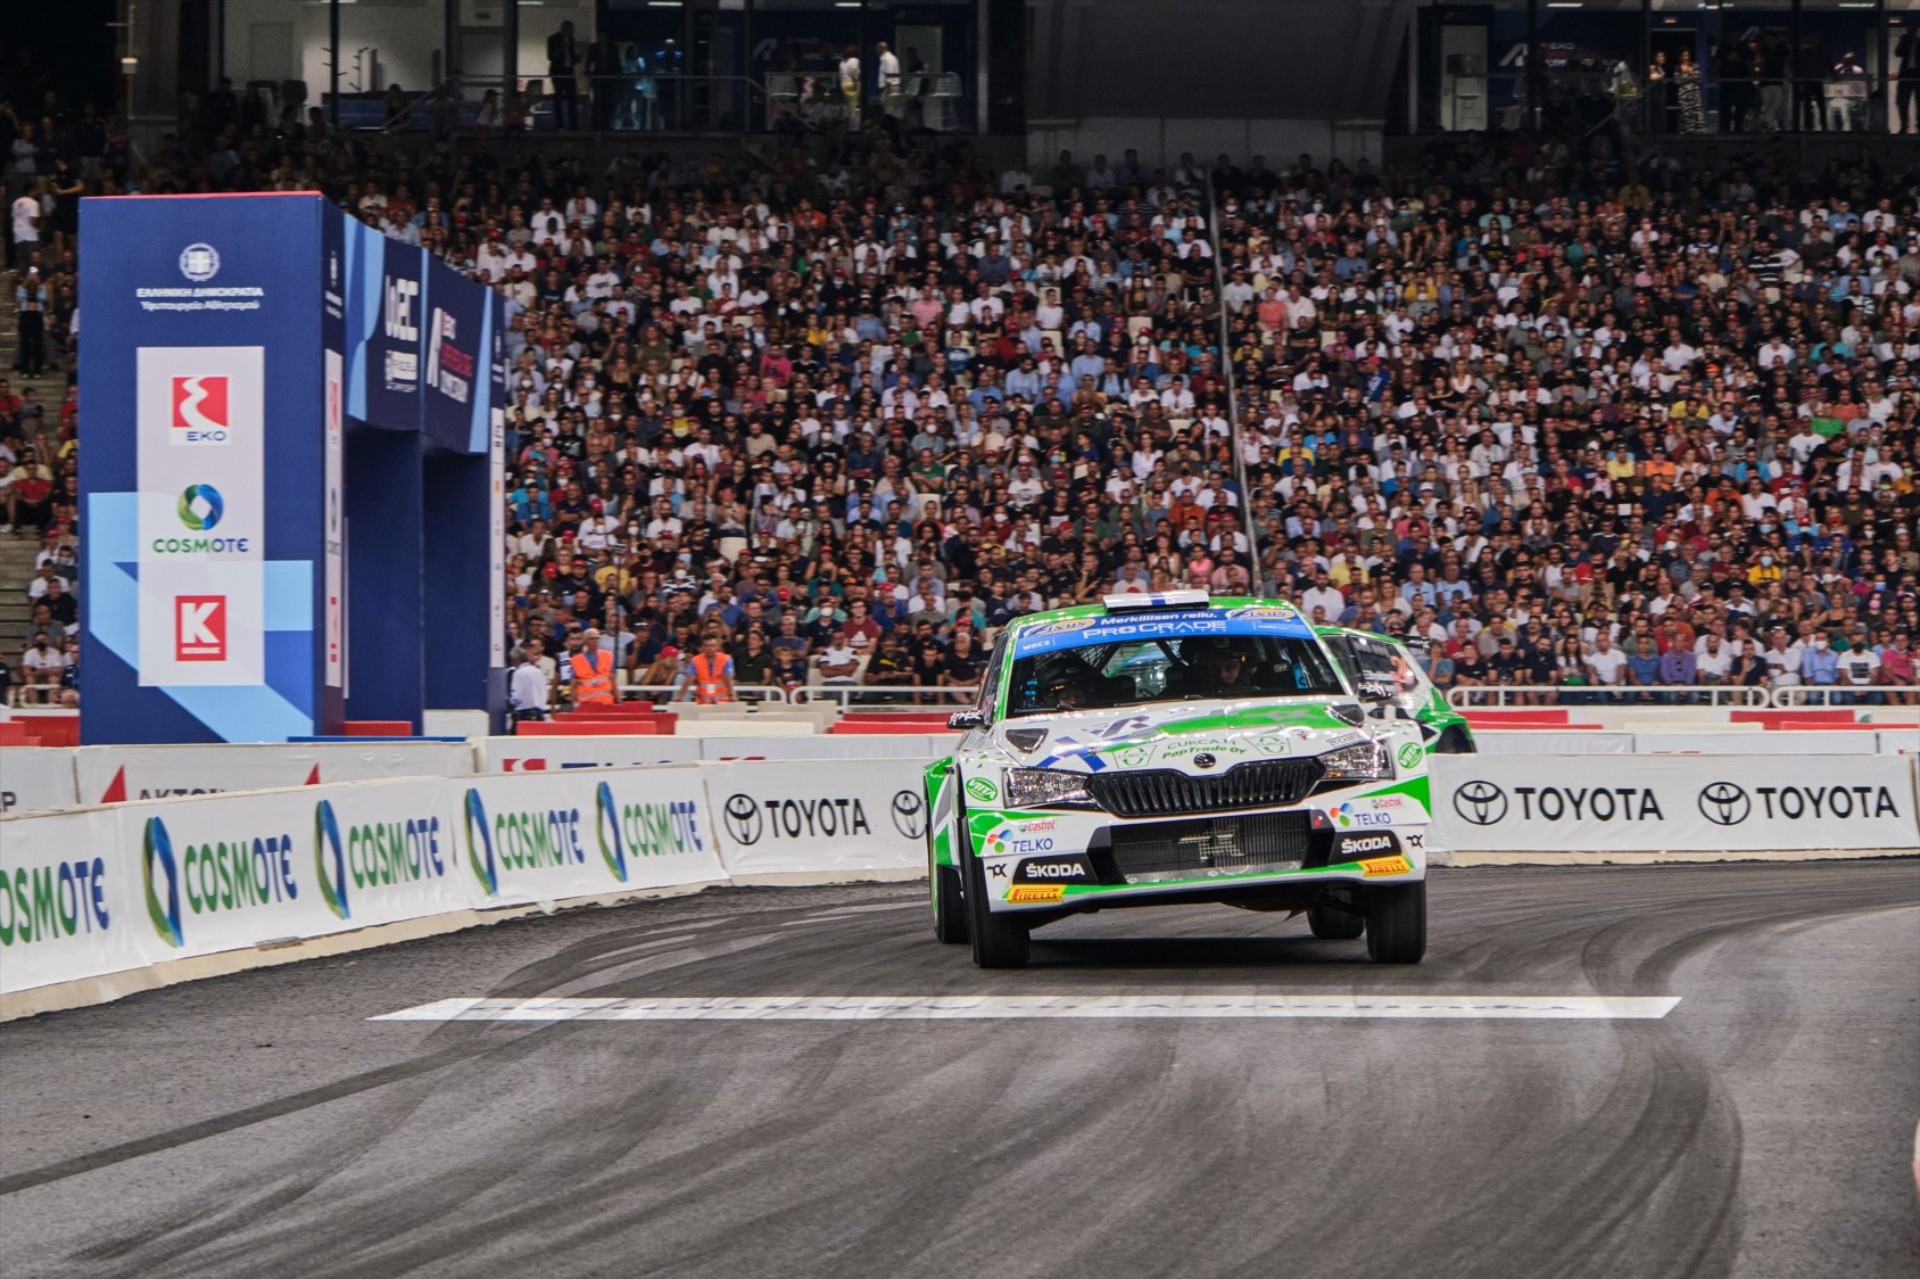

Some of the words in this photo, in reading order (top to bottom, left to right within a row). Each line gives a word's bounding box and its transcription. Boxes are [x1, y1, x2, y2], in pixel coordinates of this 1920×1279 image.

[186, 430, 226, 441] EKO
[152, 537, 249, 553] COSMOTE
[1515, 787, 1664, 821] TOYOTA
[1757, 786, 1900, 818] TOYOTA
[765, 798, 871, 838] TOYOTA
[1027, 820, 1056, 831] Castrol
[1354, 813, 1391, 826] TELKO
[624, 800, 703, 857] COSMOTE
[495, 808, 585, 871] COSMOTE
[1012, 838, 1053, 852] TELKO
[1341, 836, 1392, 854] ŠKODA
[349, 816, 445, 889] COSMOTE
[184, 834, 297, 915] COSMOTE
[1025, 863, 1085, 878] ŠKODA
[1012, 888, 1063, 901] PIRELLI
